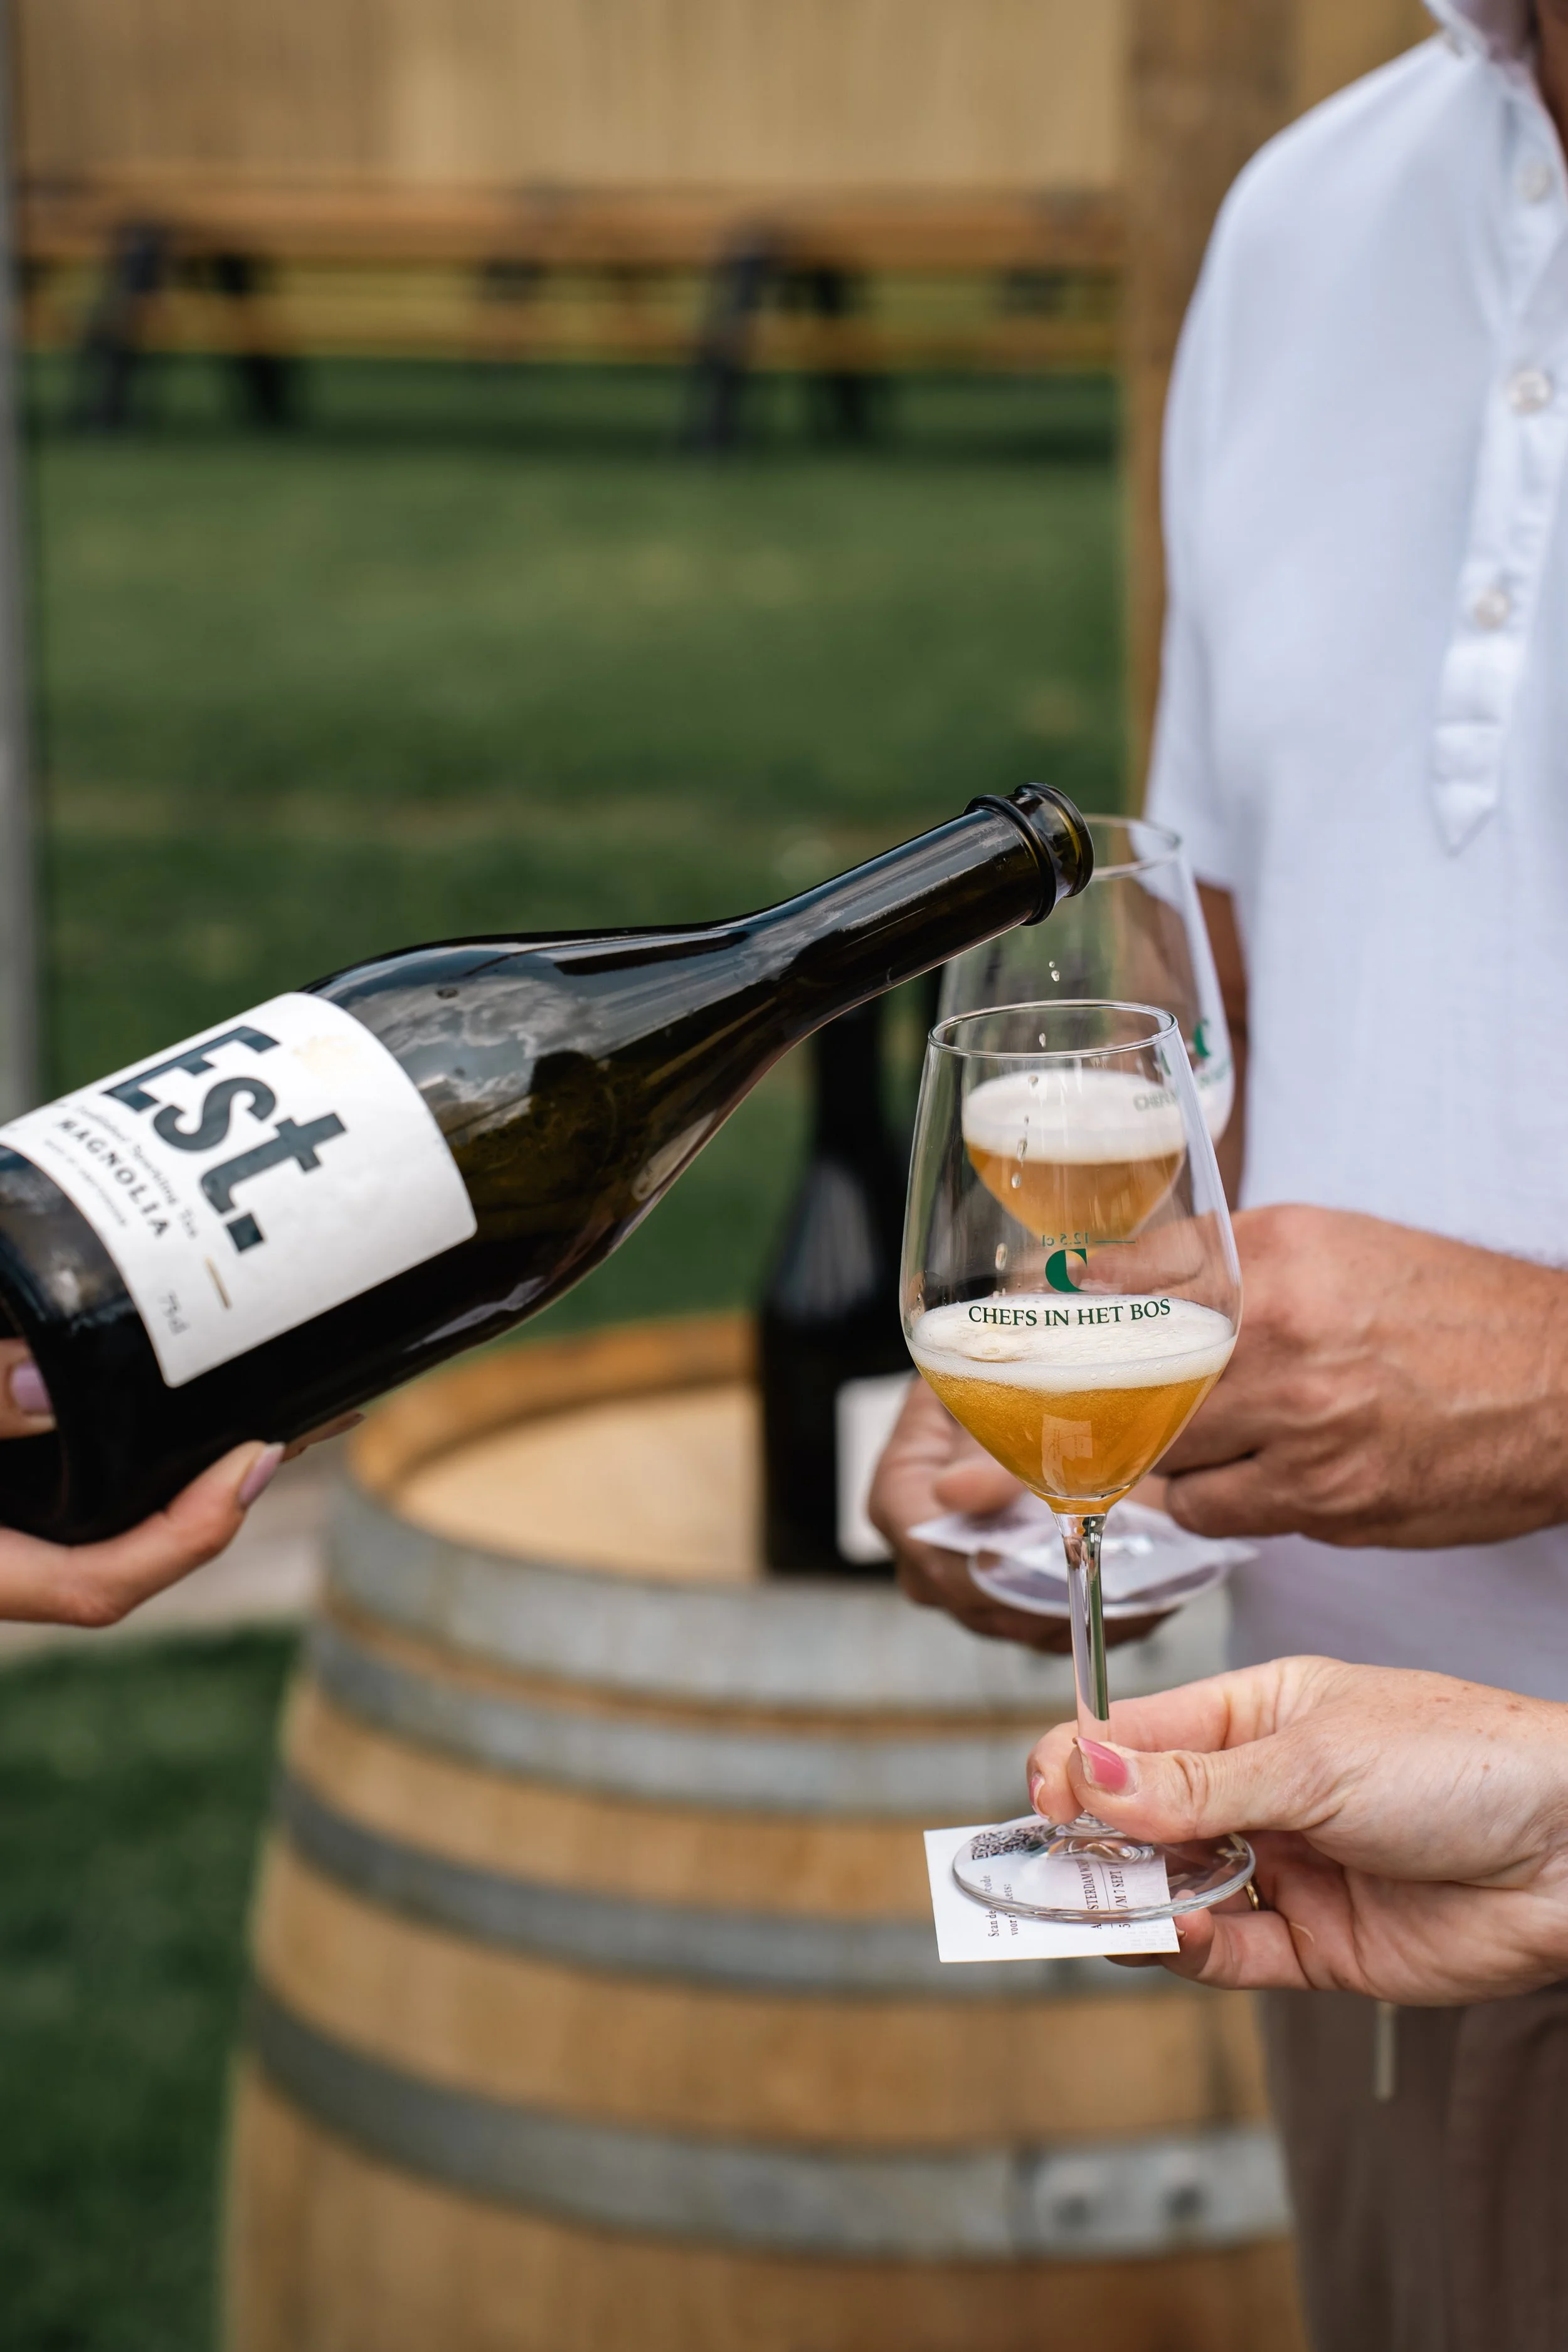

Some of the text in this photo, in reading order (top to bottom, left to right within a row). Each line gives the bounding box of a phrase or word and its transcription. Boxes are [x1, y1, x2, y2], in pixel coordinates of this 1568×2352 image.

[102, 1025, 347, 1253] Est.
[58, 1118, 169, 1239] MAGNOLIA
[968, 1298, 1171, 1327] CHEFS IN HET BOS
[1109, 1870, 1124, 1888] SEPT
[1081, 1873, 1102, 1930] ASTERDAM
[988, 1920, 1000, 1937] Scan
[1009, 1919, 1019, 1936] voor
